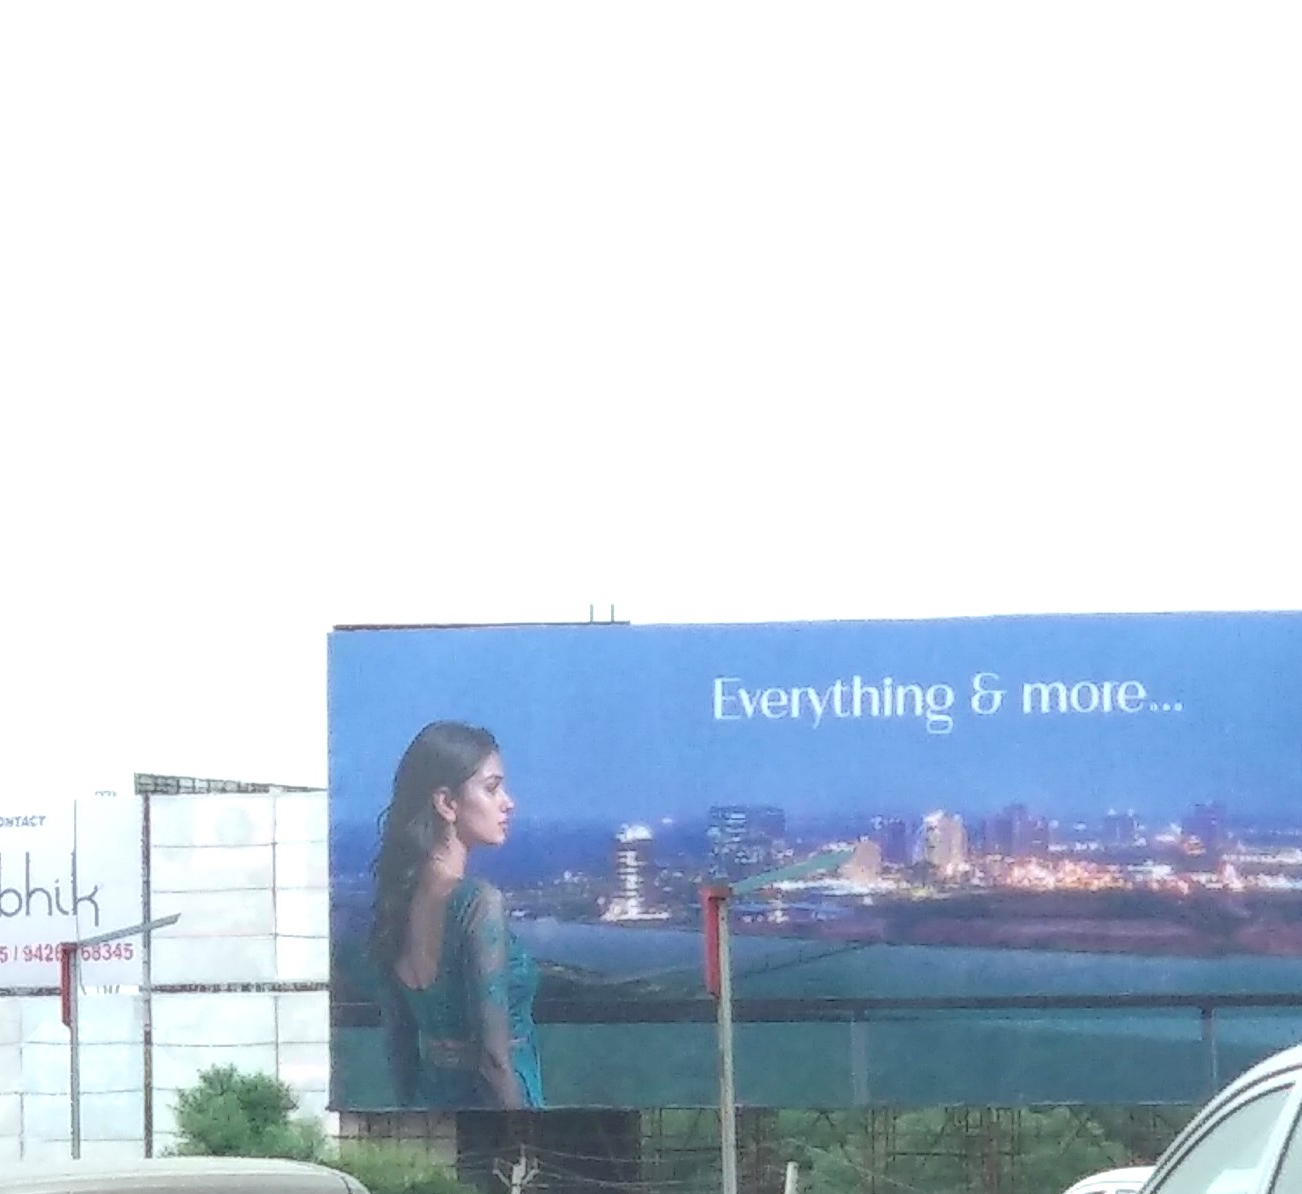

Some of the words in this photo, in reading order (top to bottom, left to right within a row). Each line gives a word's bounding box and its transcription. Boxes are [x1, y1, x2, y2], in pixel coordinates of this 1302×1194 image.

[712, 675, 955, 735] Everything
[971, 672, 1005, 714] &
[1022, 680, 1184, 714] more...
[80, 942, 134, 961] 68345
